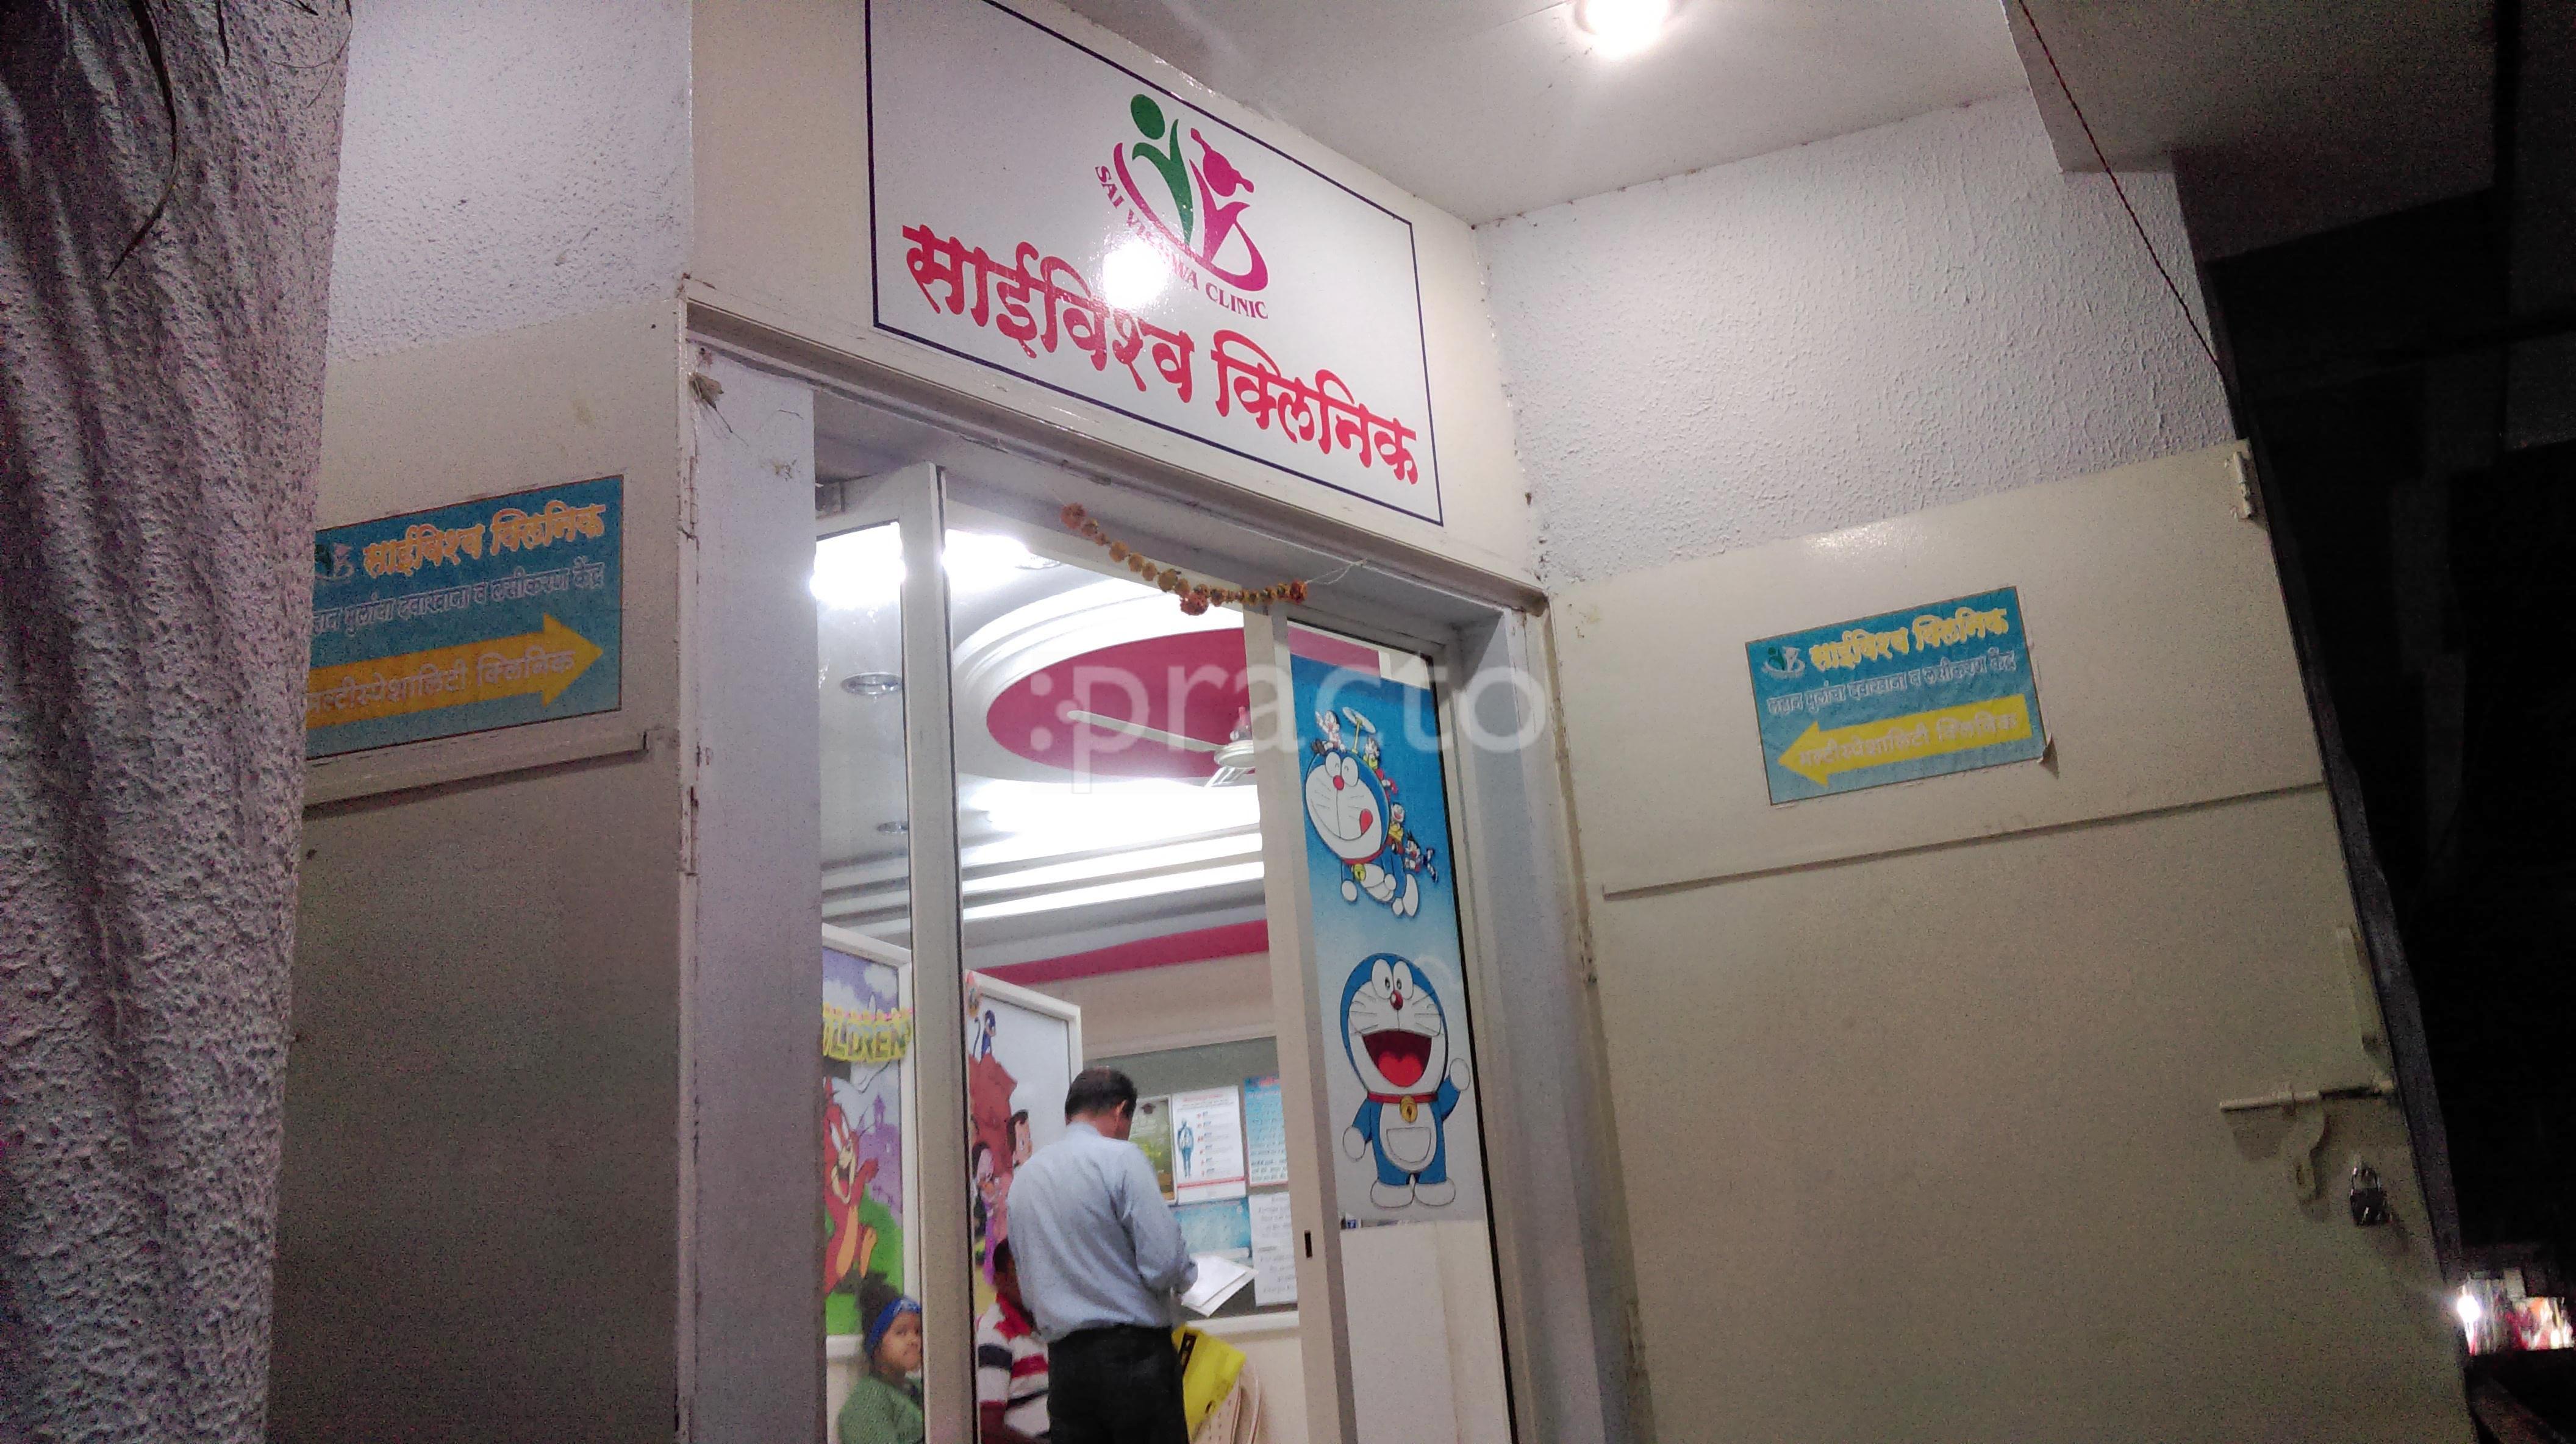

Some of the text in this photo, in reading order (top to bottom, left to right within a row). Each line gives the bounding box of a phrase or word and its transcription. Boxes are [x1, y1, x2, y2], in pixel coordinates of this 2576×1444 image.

[1095, 165, 1125, 209] SAI
[1205, 282, 1268, 319] CLINIC
[903, 224, 1419, 485] साईविश्व क्लिनिक
[363, 499, 606, 579] साईविश्व क्लिनिक
[476, 644, 576, 688] क्लिनिक
[1808, 606, 2009, 671] साईविश्व क्लिनिक
